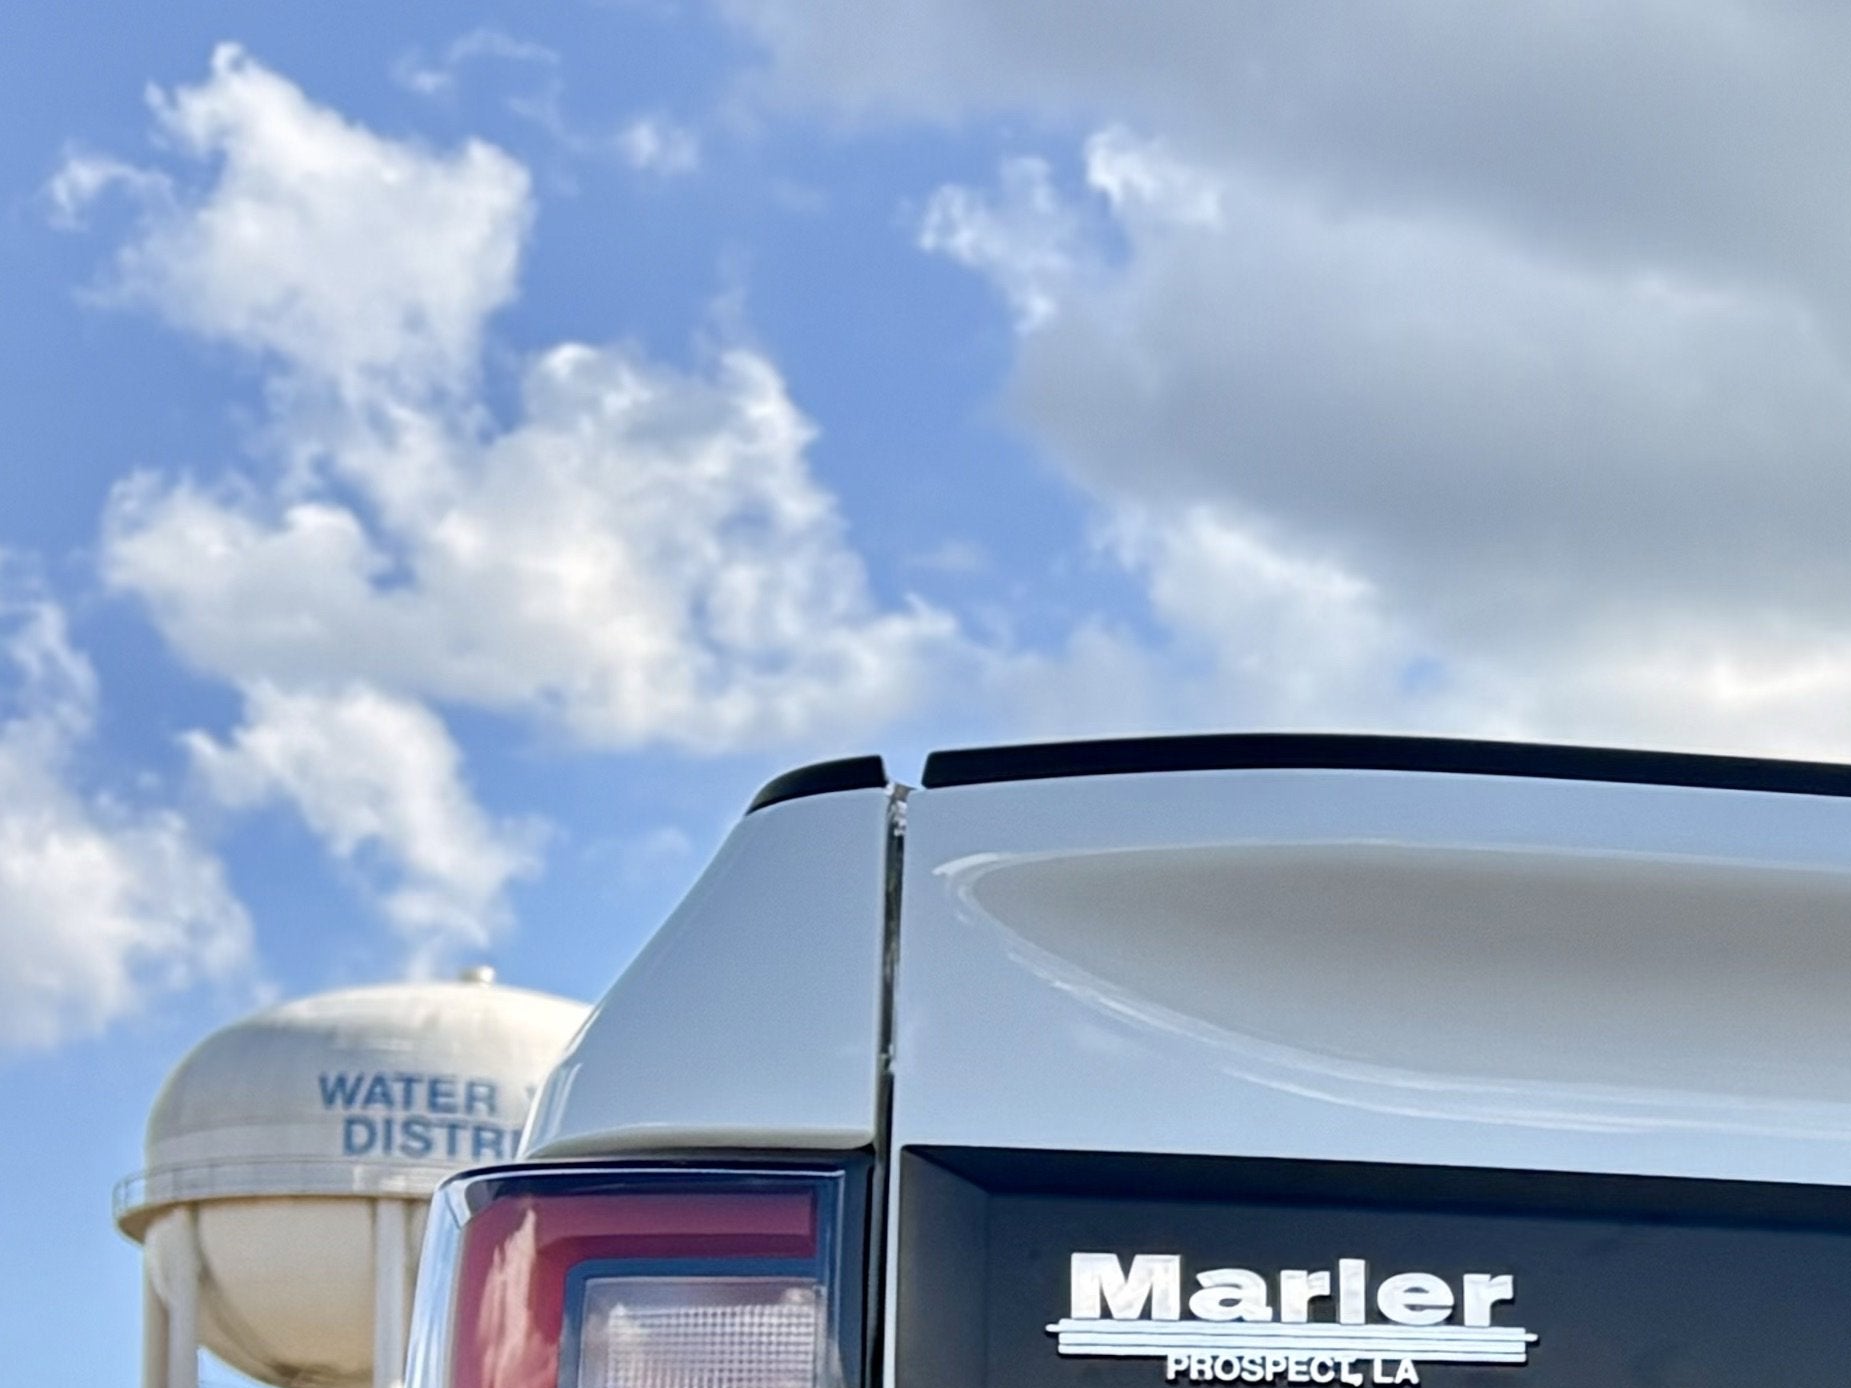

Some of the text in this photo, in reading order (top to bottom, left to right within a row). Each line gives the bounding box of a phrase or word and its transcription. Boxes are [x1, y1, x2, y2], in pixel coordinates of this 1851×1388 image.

[318, 1072, 497, 1115] WATER
[1070, 1252, 1515, 1327] Marler
[1373, 1358, 1420, 1386] LA
